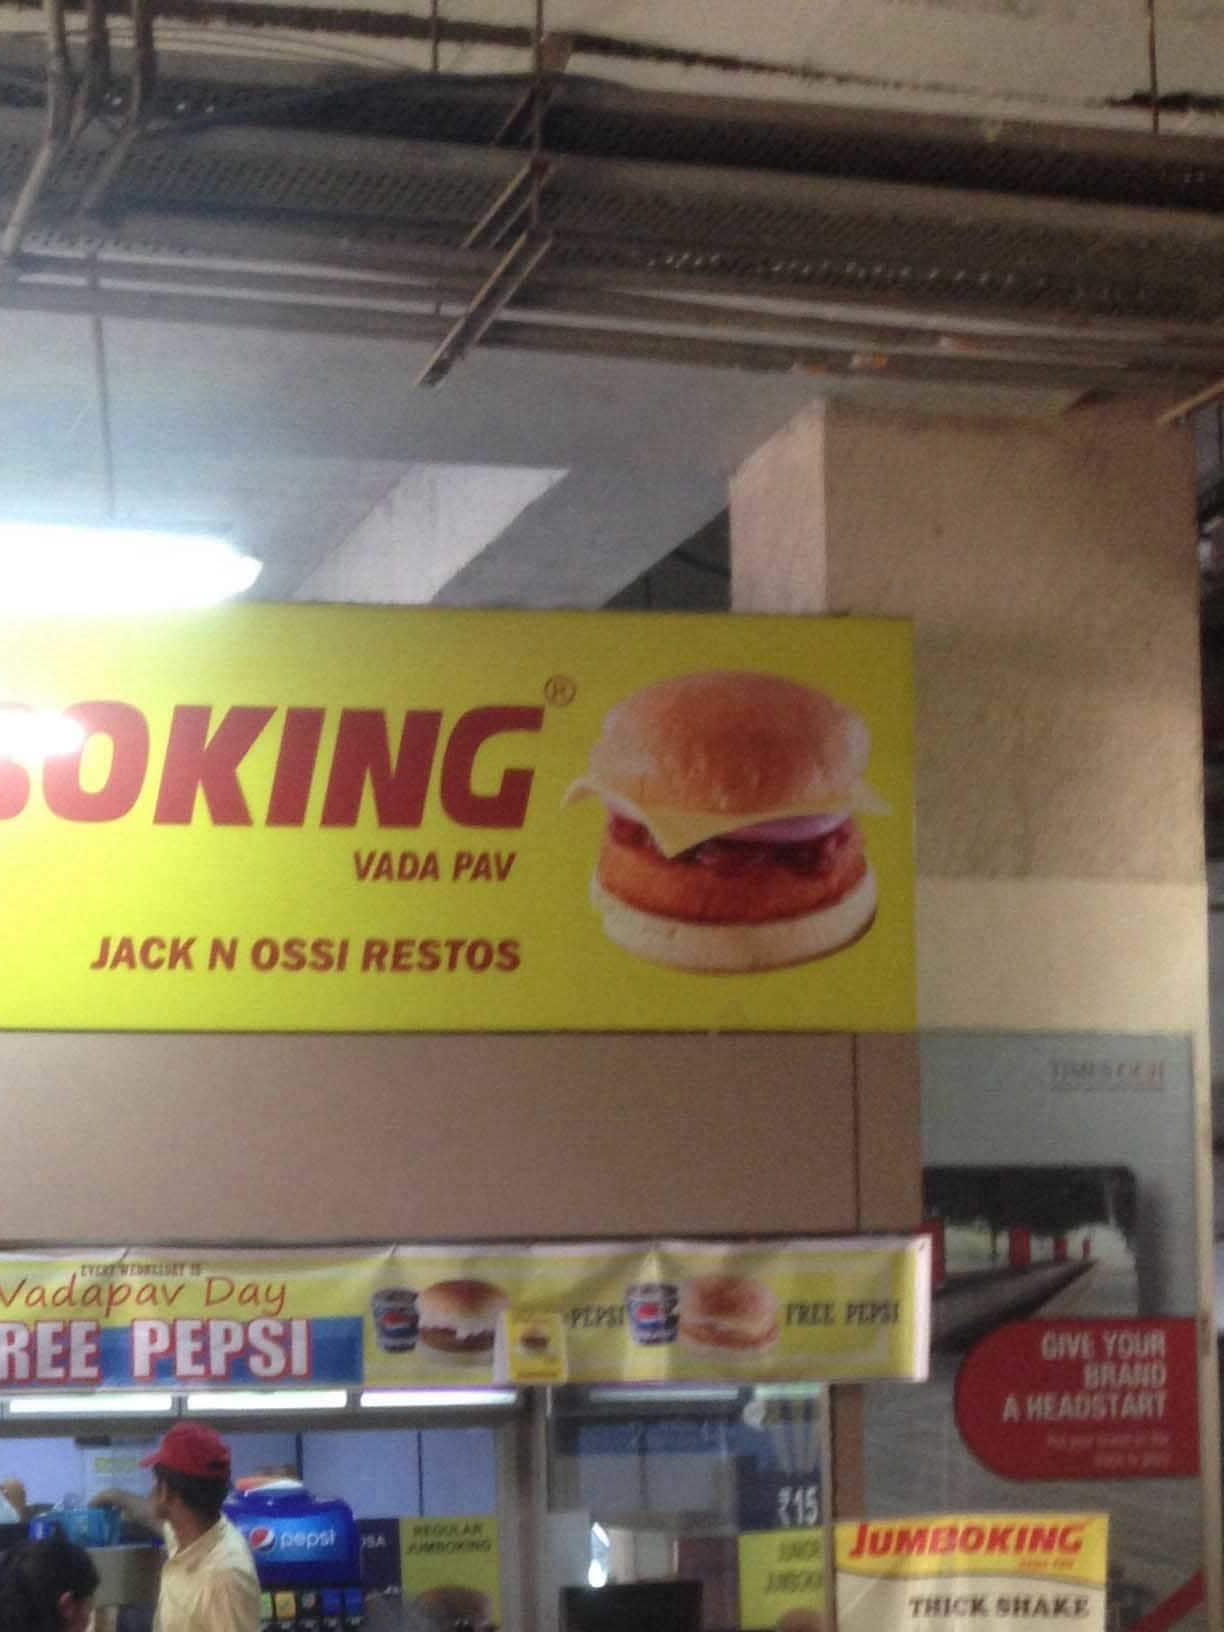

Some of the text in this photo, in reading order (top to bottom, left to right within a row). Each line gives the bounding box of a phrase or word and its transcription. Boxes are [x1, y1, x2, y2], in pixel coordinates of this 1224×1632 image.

[353, 852, 516, 882] VADA PAV
[90, 936, 522, 973] JACK N OSSI RESTOS
[204, 1274, 287, 1316] Day
[785, 1301, 835, 1327] FREE
[130, 1317, 314, 1385] PEPSI
[1041, 1329, 1166, 1360] GIVE YOUR
[1083, 1361, 1167, 1389] BRAND
[1002, 1390, 1167, 1423] A HEADSTART
[279, 1528, 336, 1550] pepsi
[849, 1518, 1084, 1558] JUMBOKING
[908, 1595, 1091, 1619] THICK SHAKE
